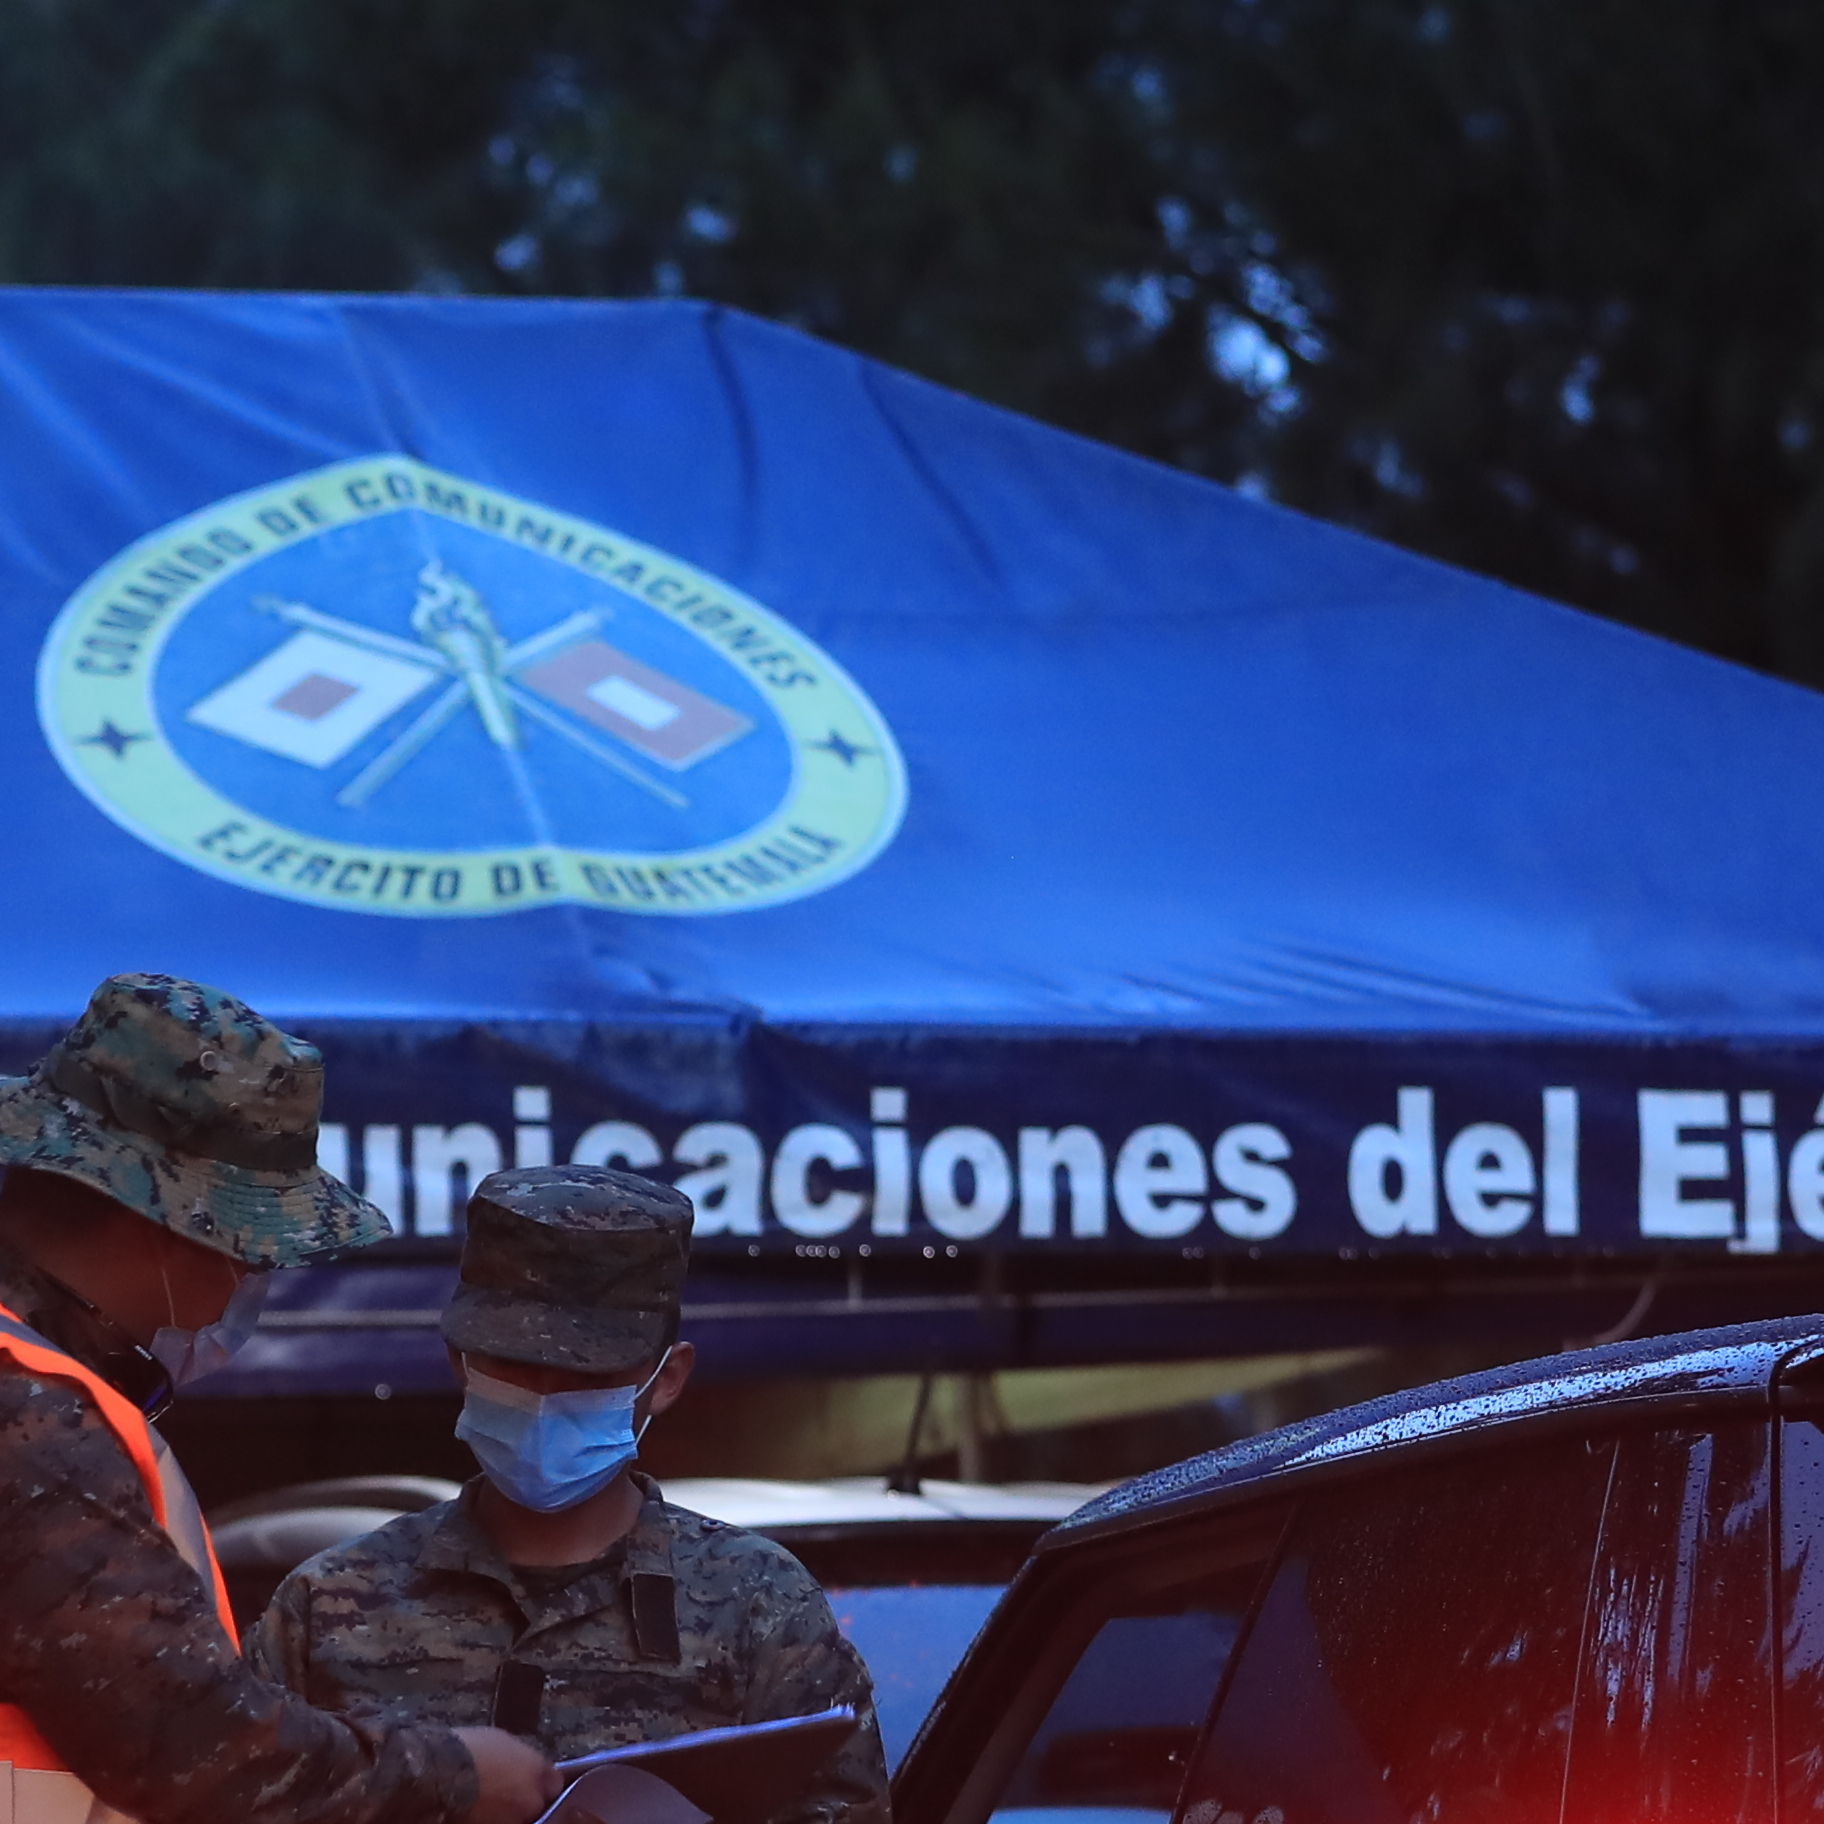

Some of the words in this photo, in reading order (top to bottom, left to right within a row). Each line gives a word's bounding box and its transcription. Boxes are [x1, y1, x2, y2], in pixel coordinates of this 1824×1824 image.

[73, 525, 254, 677] COMANDO
[254, 495, 324, 538] DE
[343, 472, 819, 690] COMUNICACIONES
[195, 820, 464, 902] EJERCITO
[490, 859, 562, 896] DE
[579, 822, 844, 903] GUATEMALA
[1347, 1087, 1579, 1237] del
